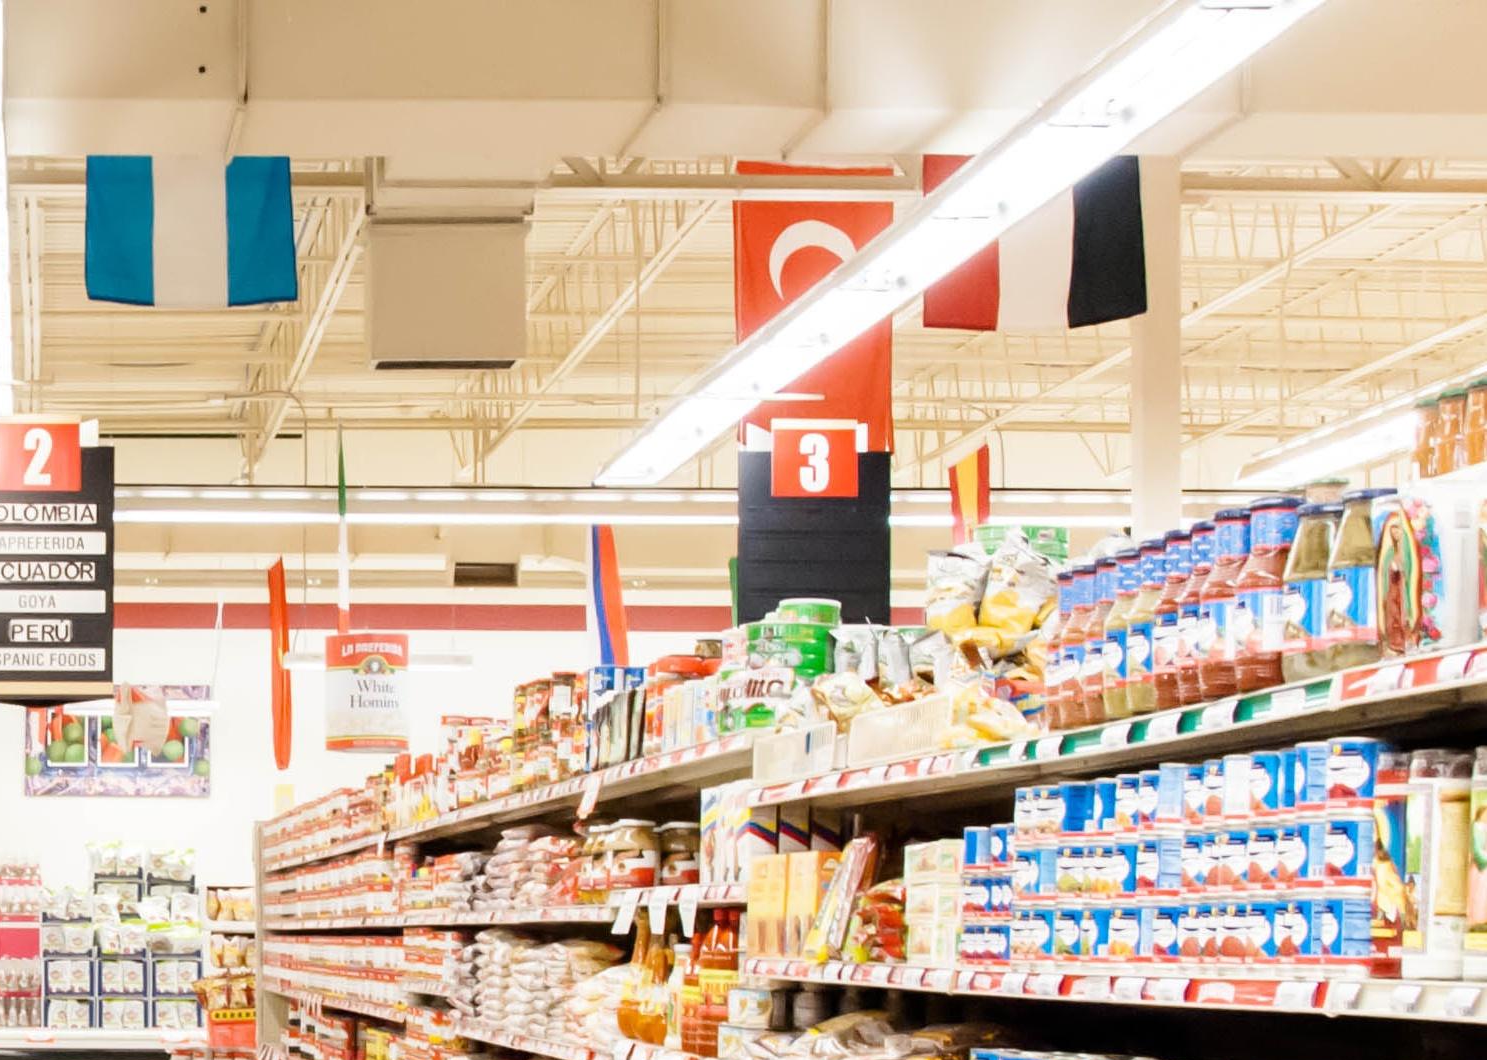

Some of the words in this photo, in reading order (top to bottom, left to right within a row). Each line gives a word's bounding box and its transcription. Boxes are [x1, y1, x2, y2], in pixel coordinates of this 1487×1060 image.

[23, 428, 53, 486] 2
[799, 433, 830, 493] 3
[18, 594, 56, 608] GOYA
[50, 653, 97, 666] FOODS
